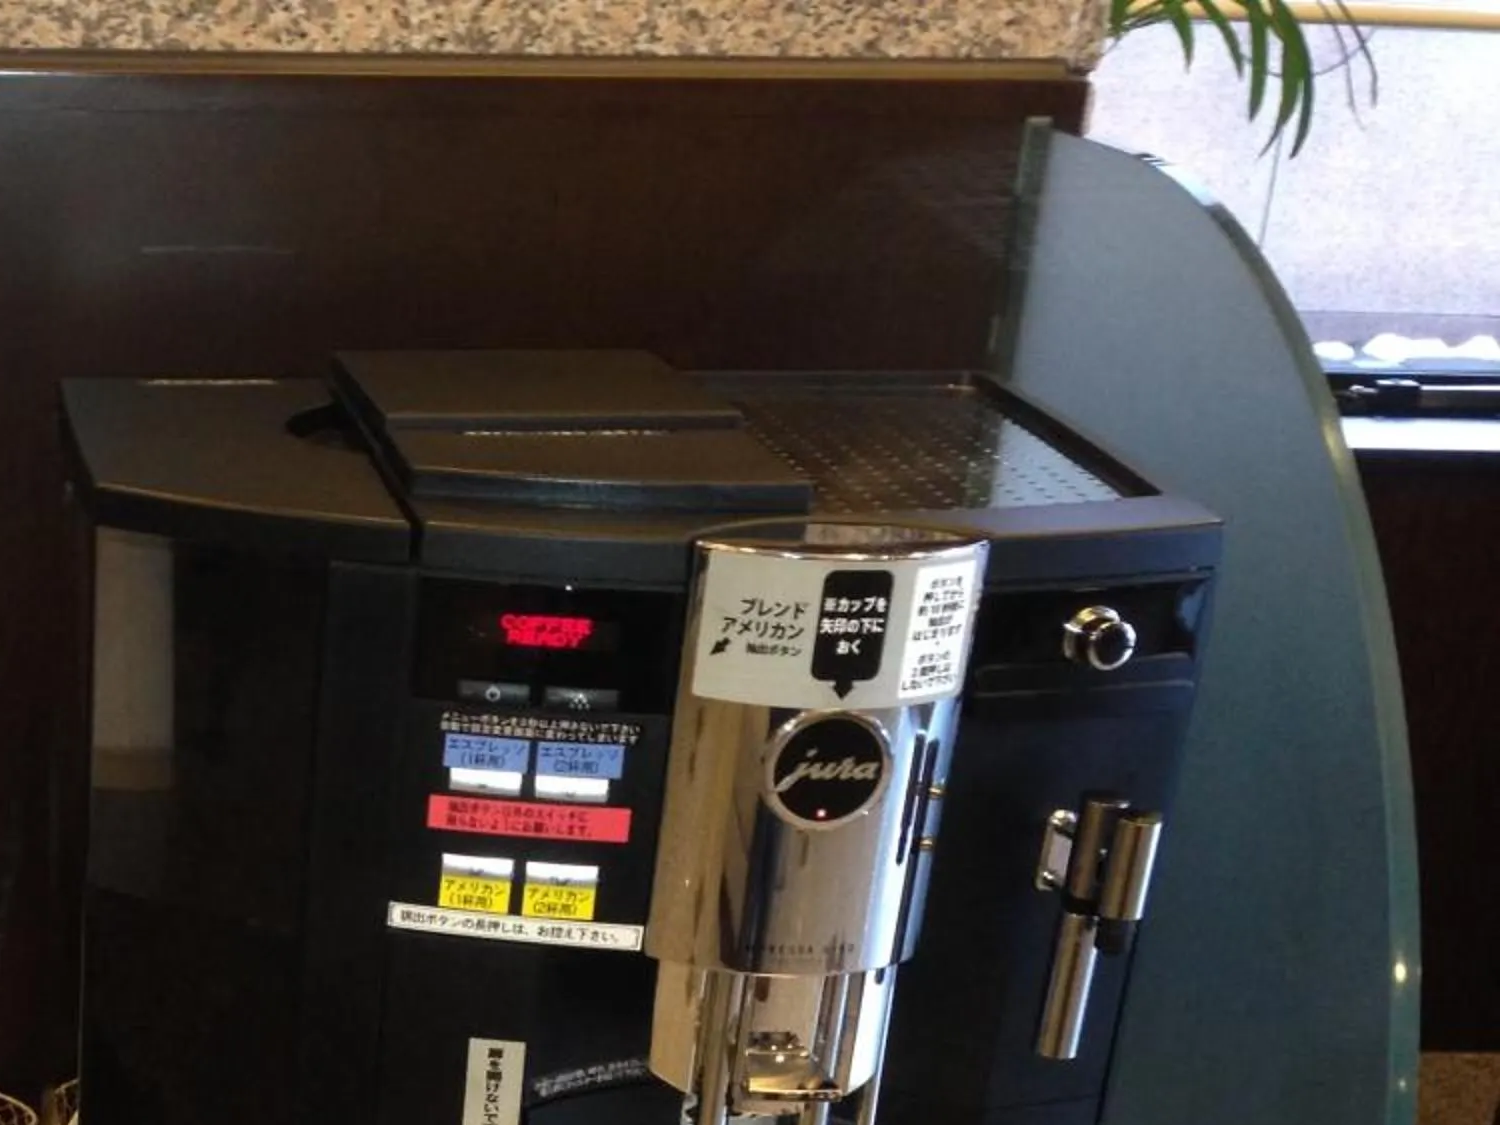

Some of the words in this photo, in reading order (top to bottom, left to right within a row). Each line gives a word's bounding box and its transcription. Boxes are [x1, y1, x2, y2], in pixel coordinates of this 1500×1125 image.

[741, 598, 810, 620] ブレンド
[721, 617, 805, 641] アメリカン
[820, 617, 886, 635] 矢印の下に
[505, 630, 583, 648] READY
[836, 639, 861, 655] おく
[448, 738, 524, 757] エスプレッソ
[540, 745, 619, 763] エスプレッソ
[775, 748, 881, 793] jura
[444, 878, 506, 897] アメリカン
[528, 887, 592, 904] アメリカン
